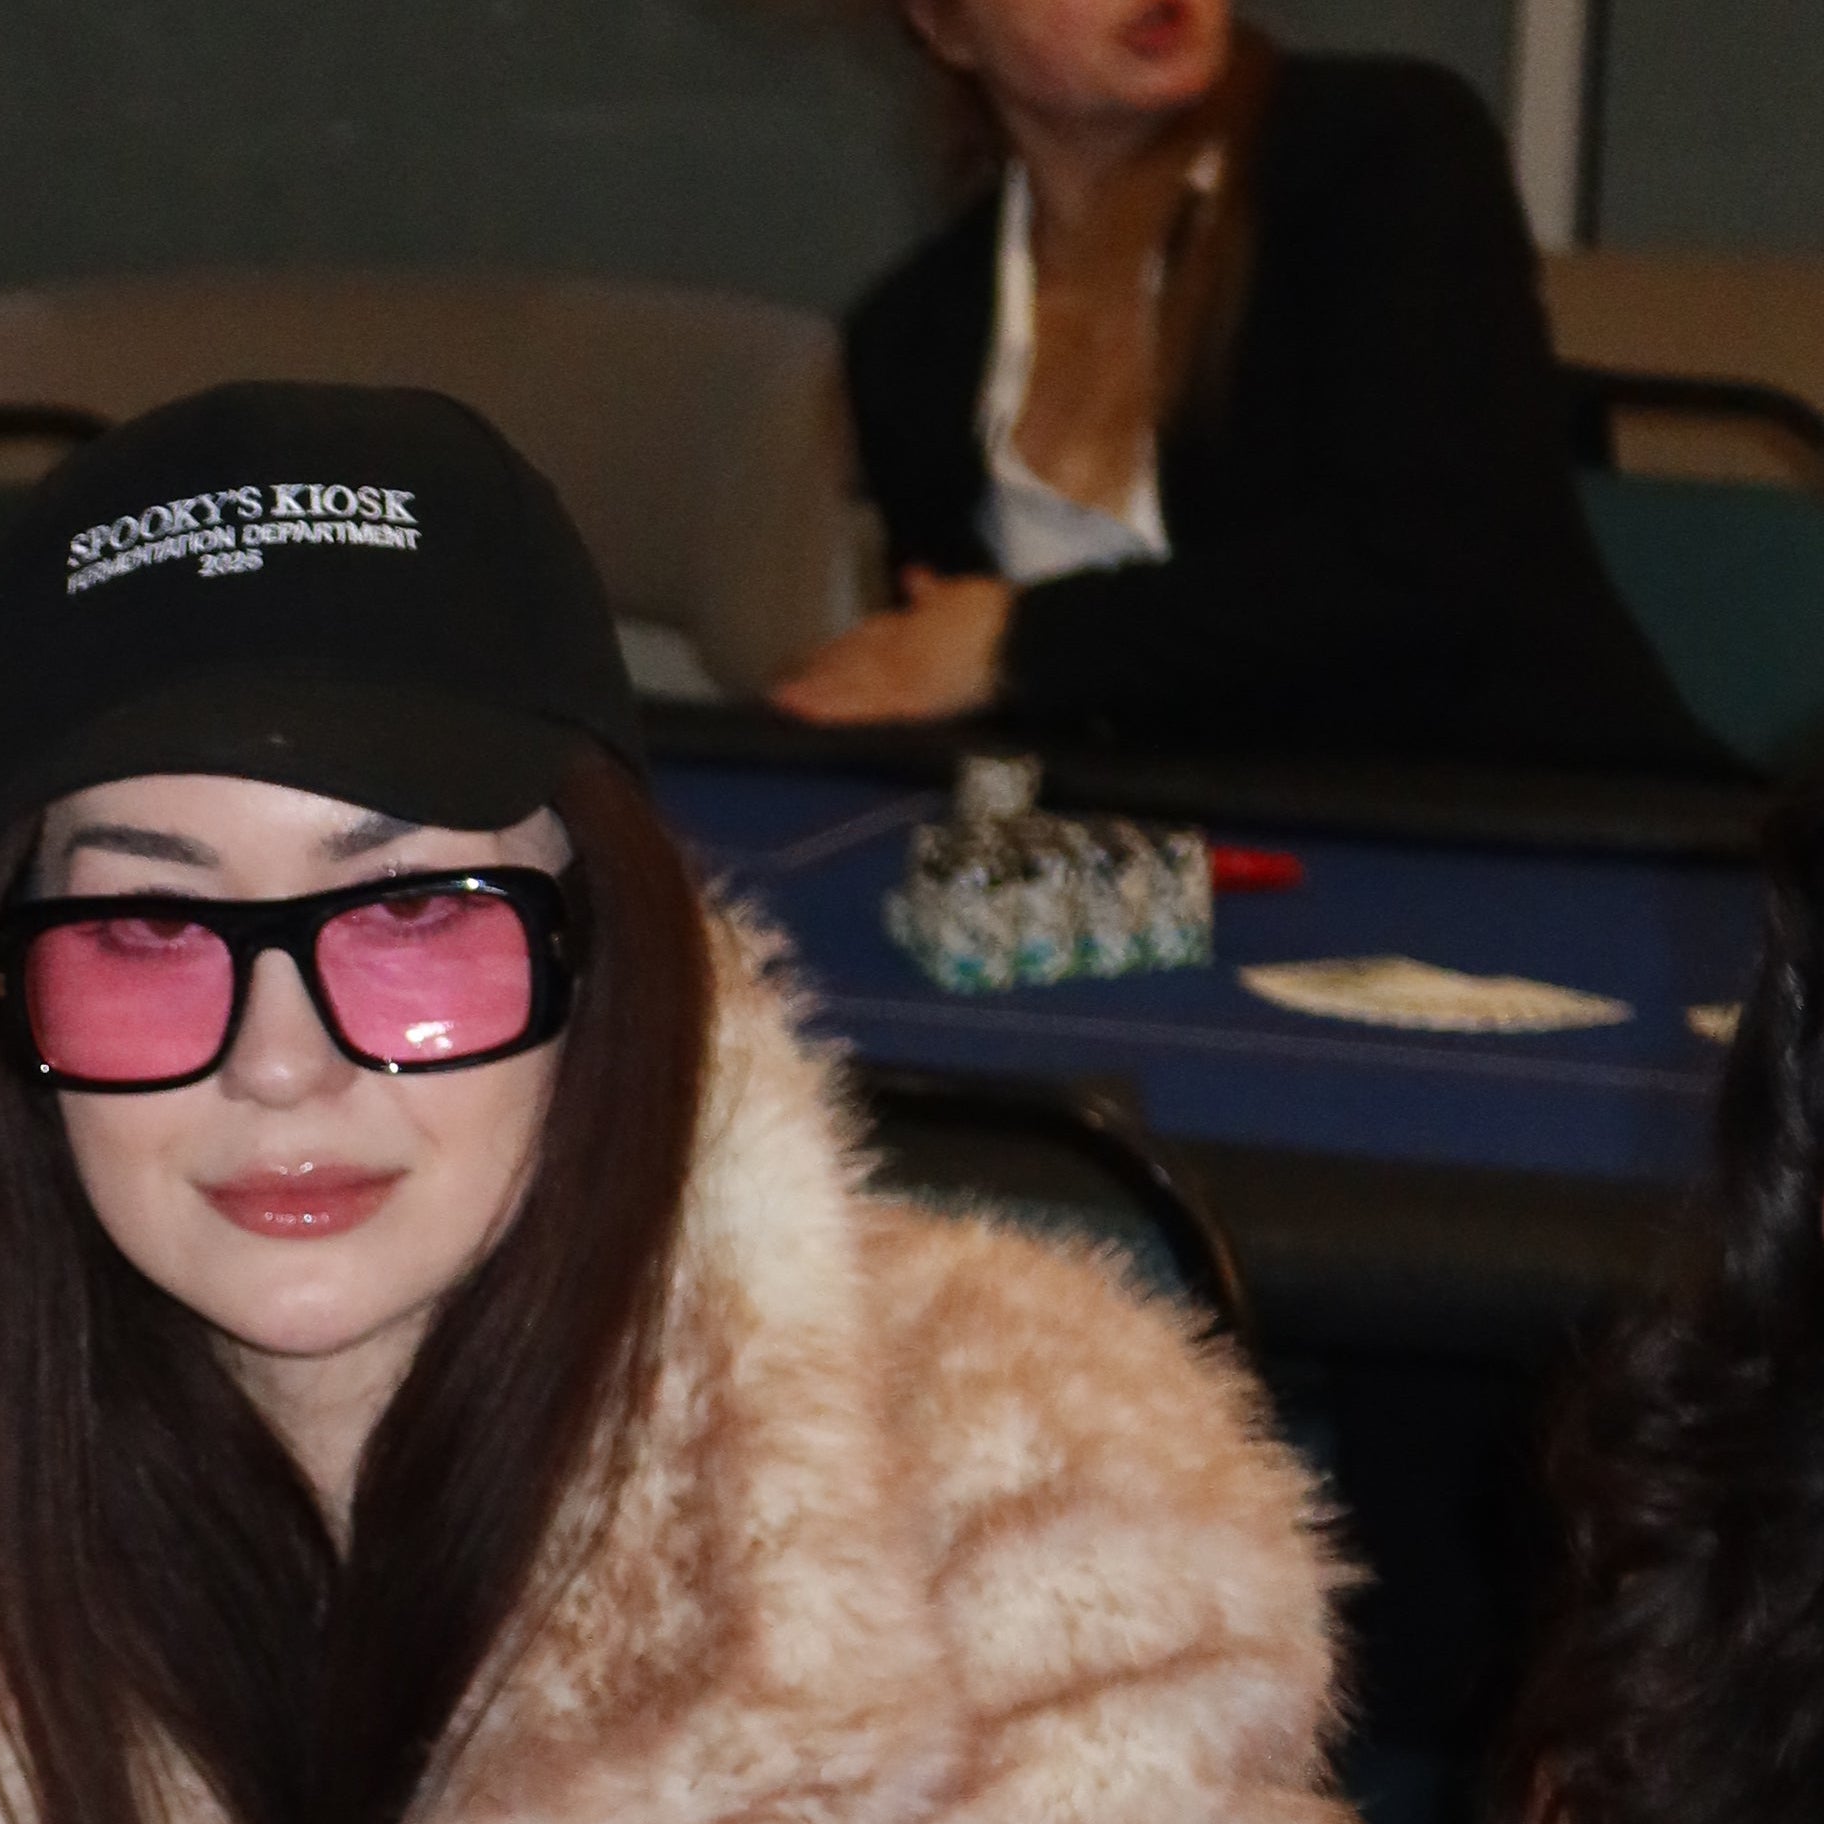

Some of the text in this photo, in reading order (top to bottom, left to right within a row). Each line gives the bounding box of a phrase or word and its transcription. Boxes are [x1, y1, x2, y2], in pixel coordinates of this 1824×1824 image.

[66, 483, 418, 567] SPOOKY'S KIOSK
[242, 520, 422, 551] DEPARTMENT
[197, 549, 263, 577] 2025
